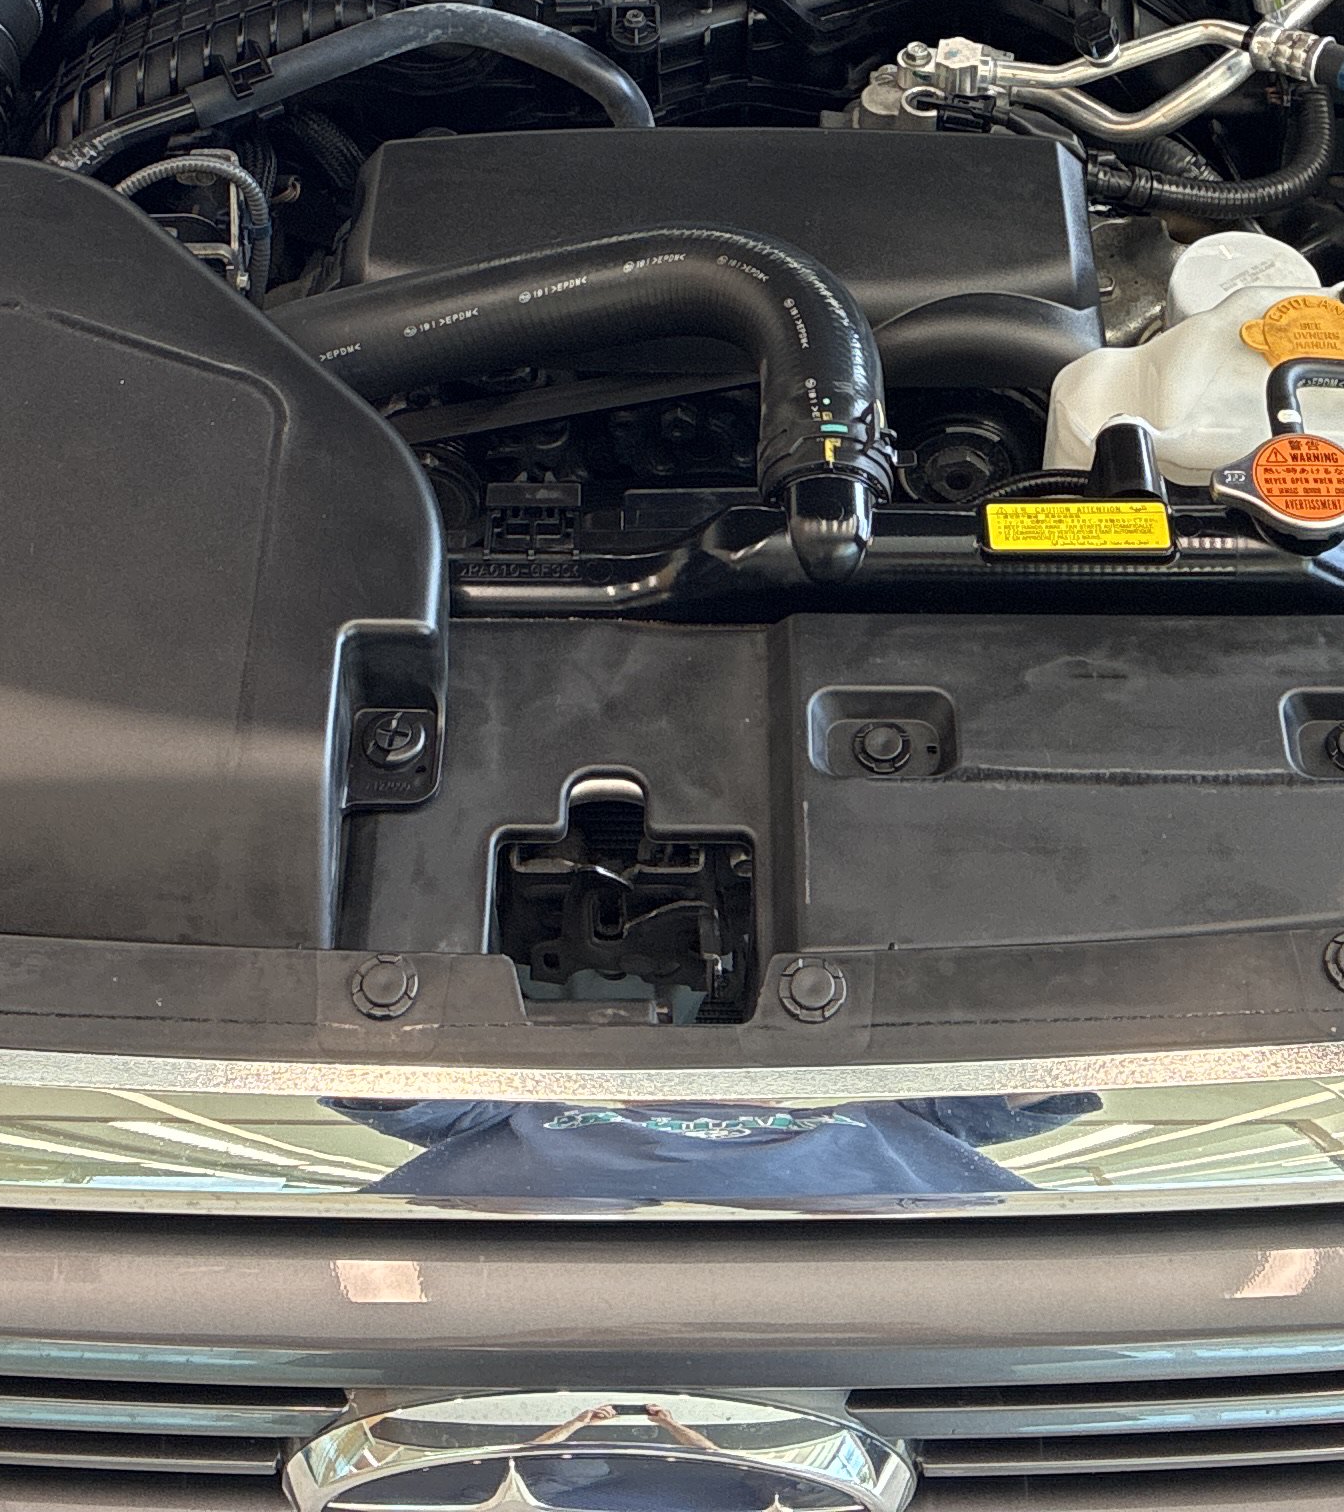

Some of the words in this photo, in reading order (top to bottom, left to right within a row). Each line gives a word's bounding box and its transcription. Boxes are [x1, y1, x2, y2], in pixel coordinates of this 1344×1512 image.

[1299, 322, 1322, 331] SEE
[1294, 342, 1341, 351] MANUAL
[1288, 440, 1320, 451] 警告
[1290, 452, 1339, 464] WARNING
[1264, 477, 1287, 485] NEVER
[1291, 477, 1310, 485] OPEN
[1313, 477, 1334, 485] WHEN
[1035, 506, 1071, 514] CAUTION
[1077, 506, 1121, 514] ATTENTION
